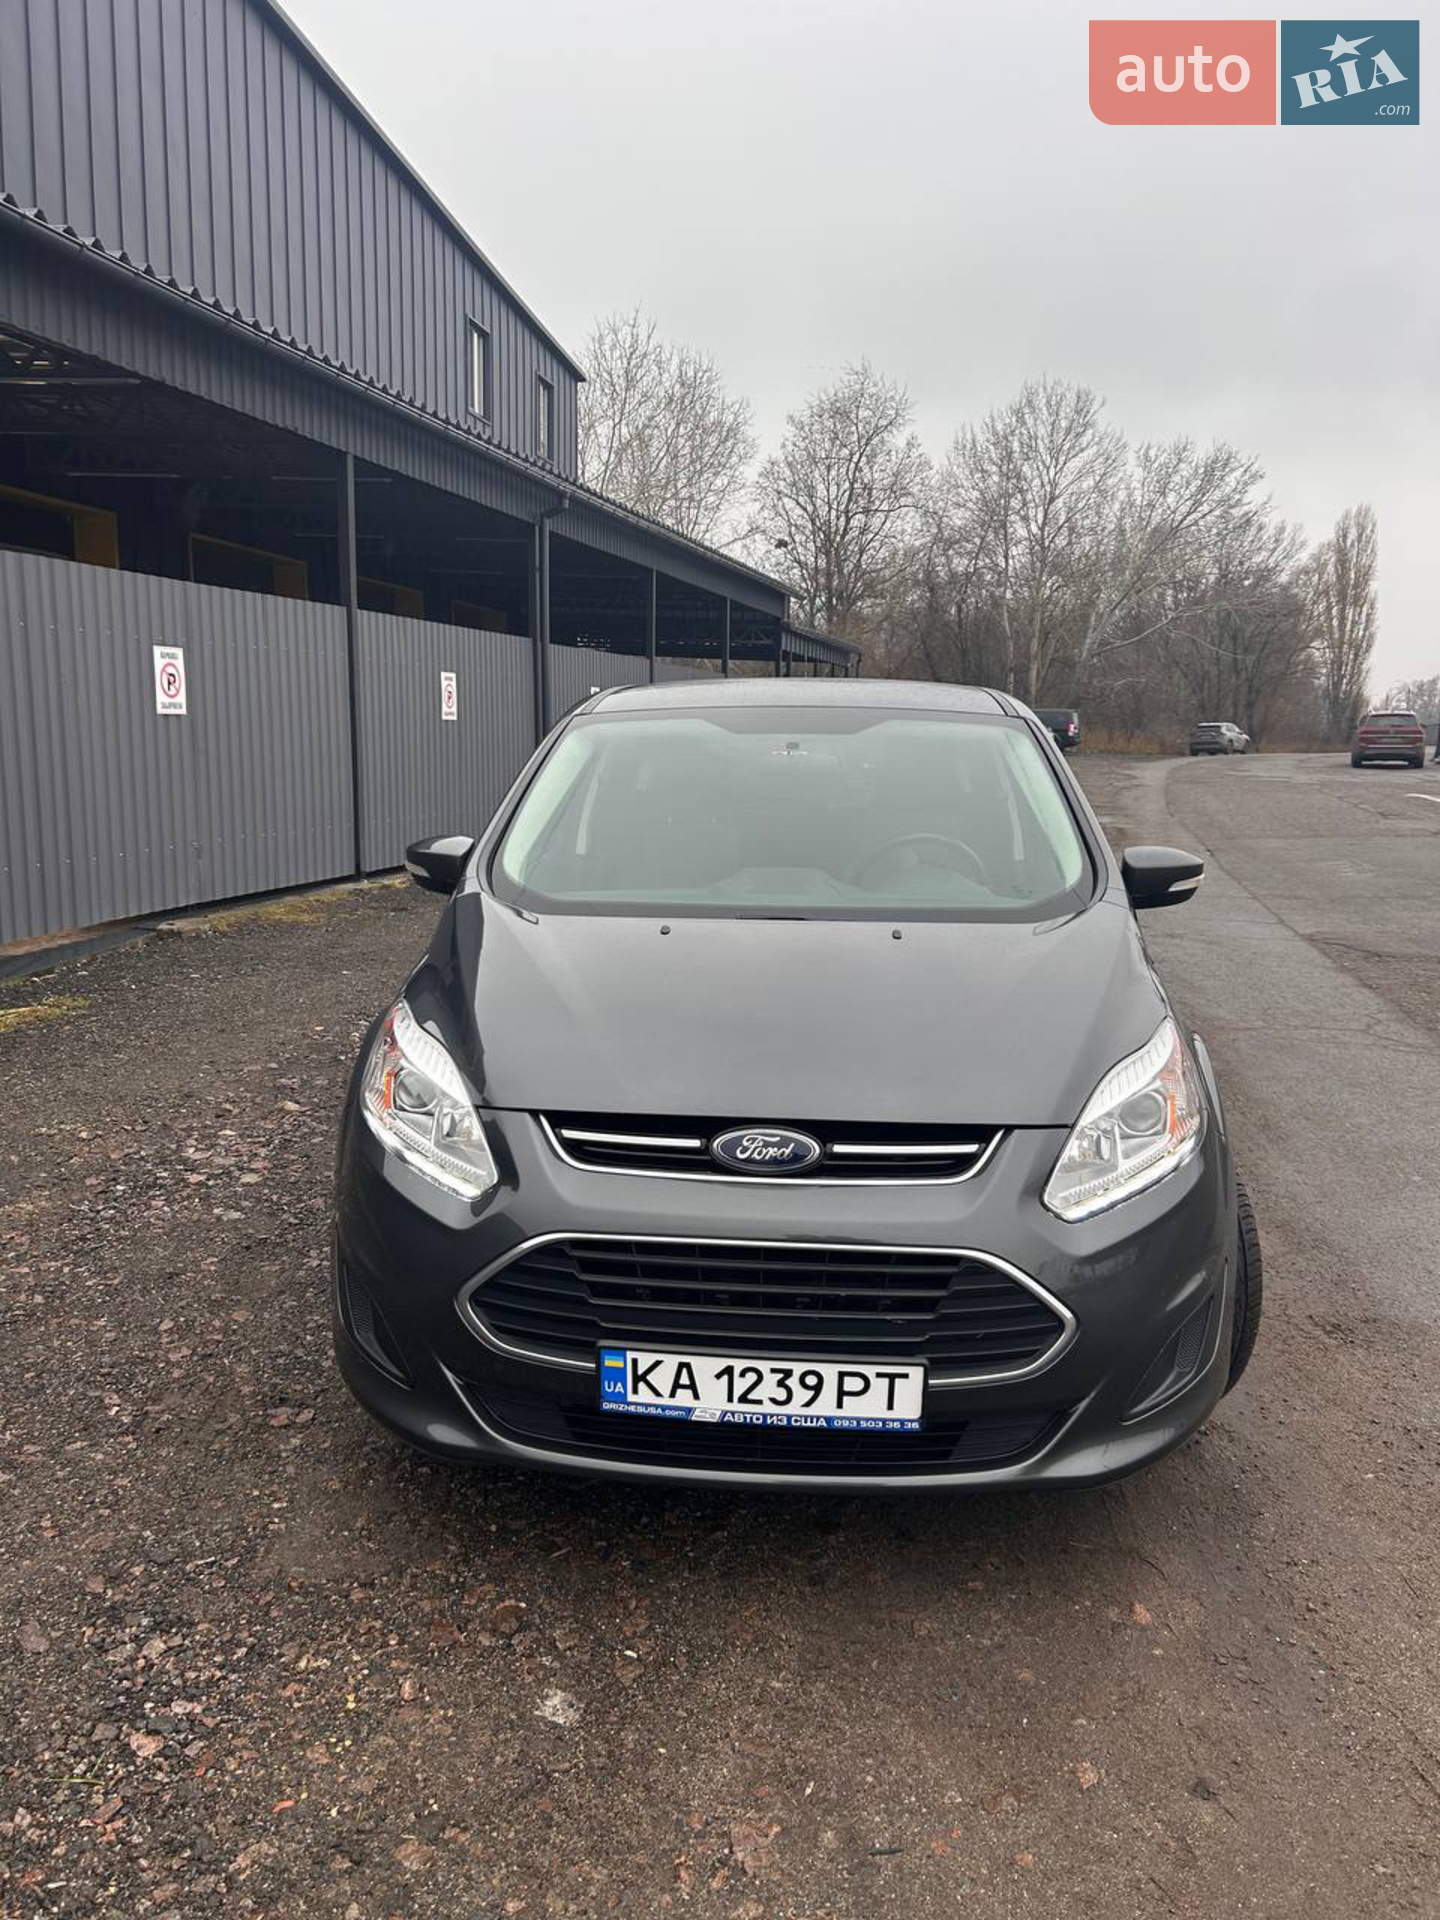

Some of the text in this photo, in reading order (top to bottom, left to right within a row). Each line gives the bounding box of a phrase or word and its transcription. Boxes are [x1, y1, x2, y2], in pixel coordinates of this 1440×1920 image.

[736, 1135, 795, 1160] Ford
[604, 1380, 625, 1394] UA
[714, 1364, 824, 1407] 1239
[723, 1412, 828, 1428] АВТО ИЗ США
